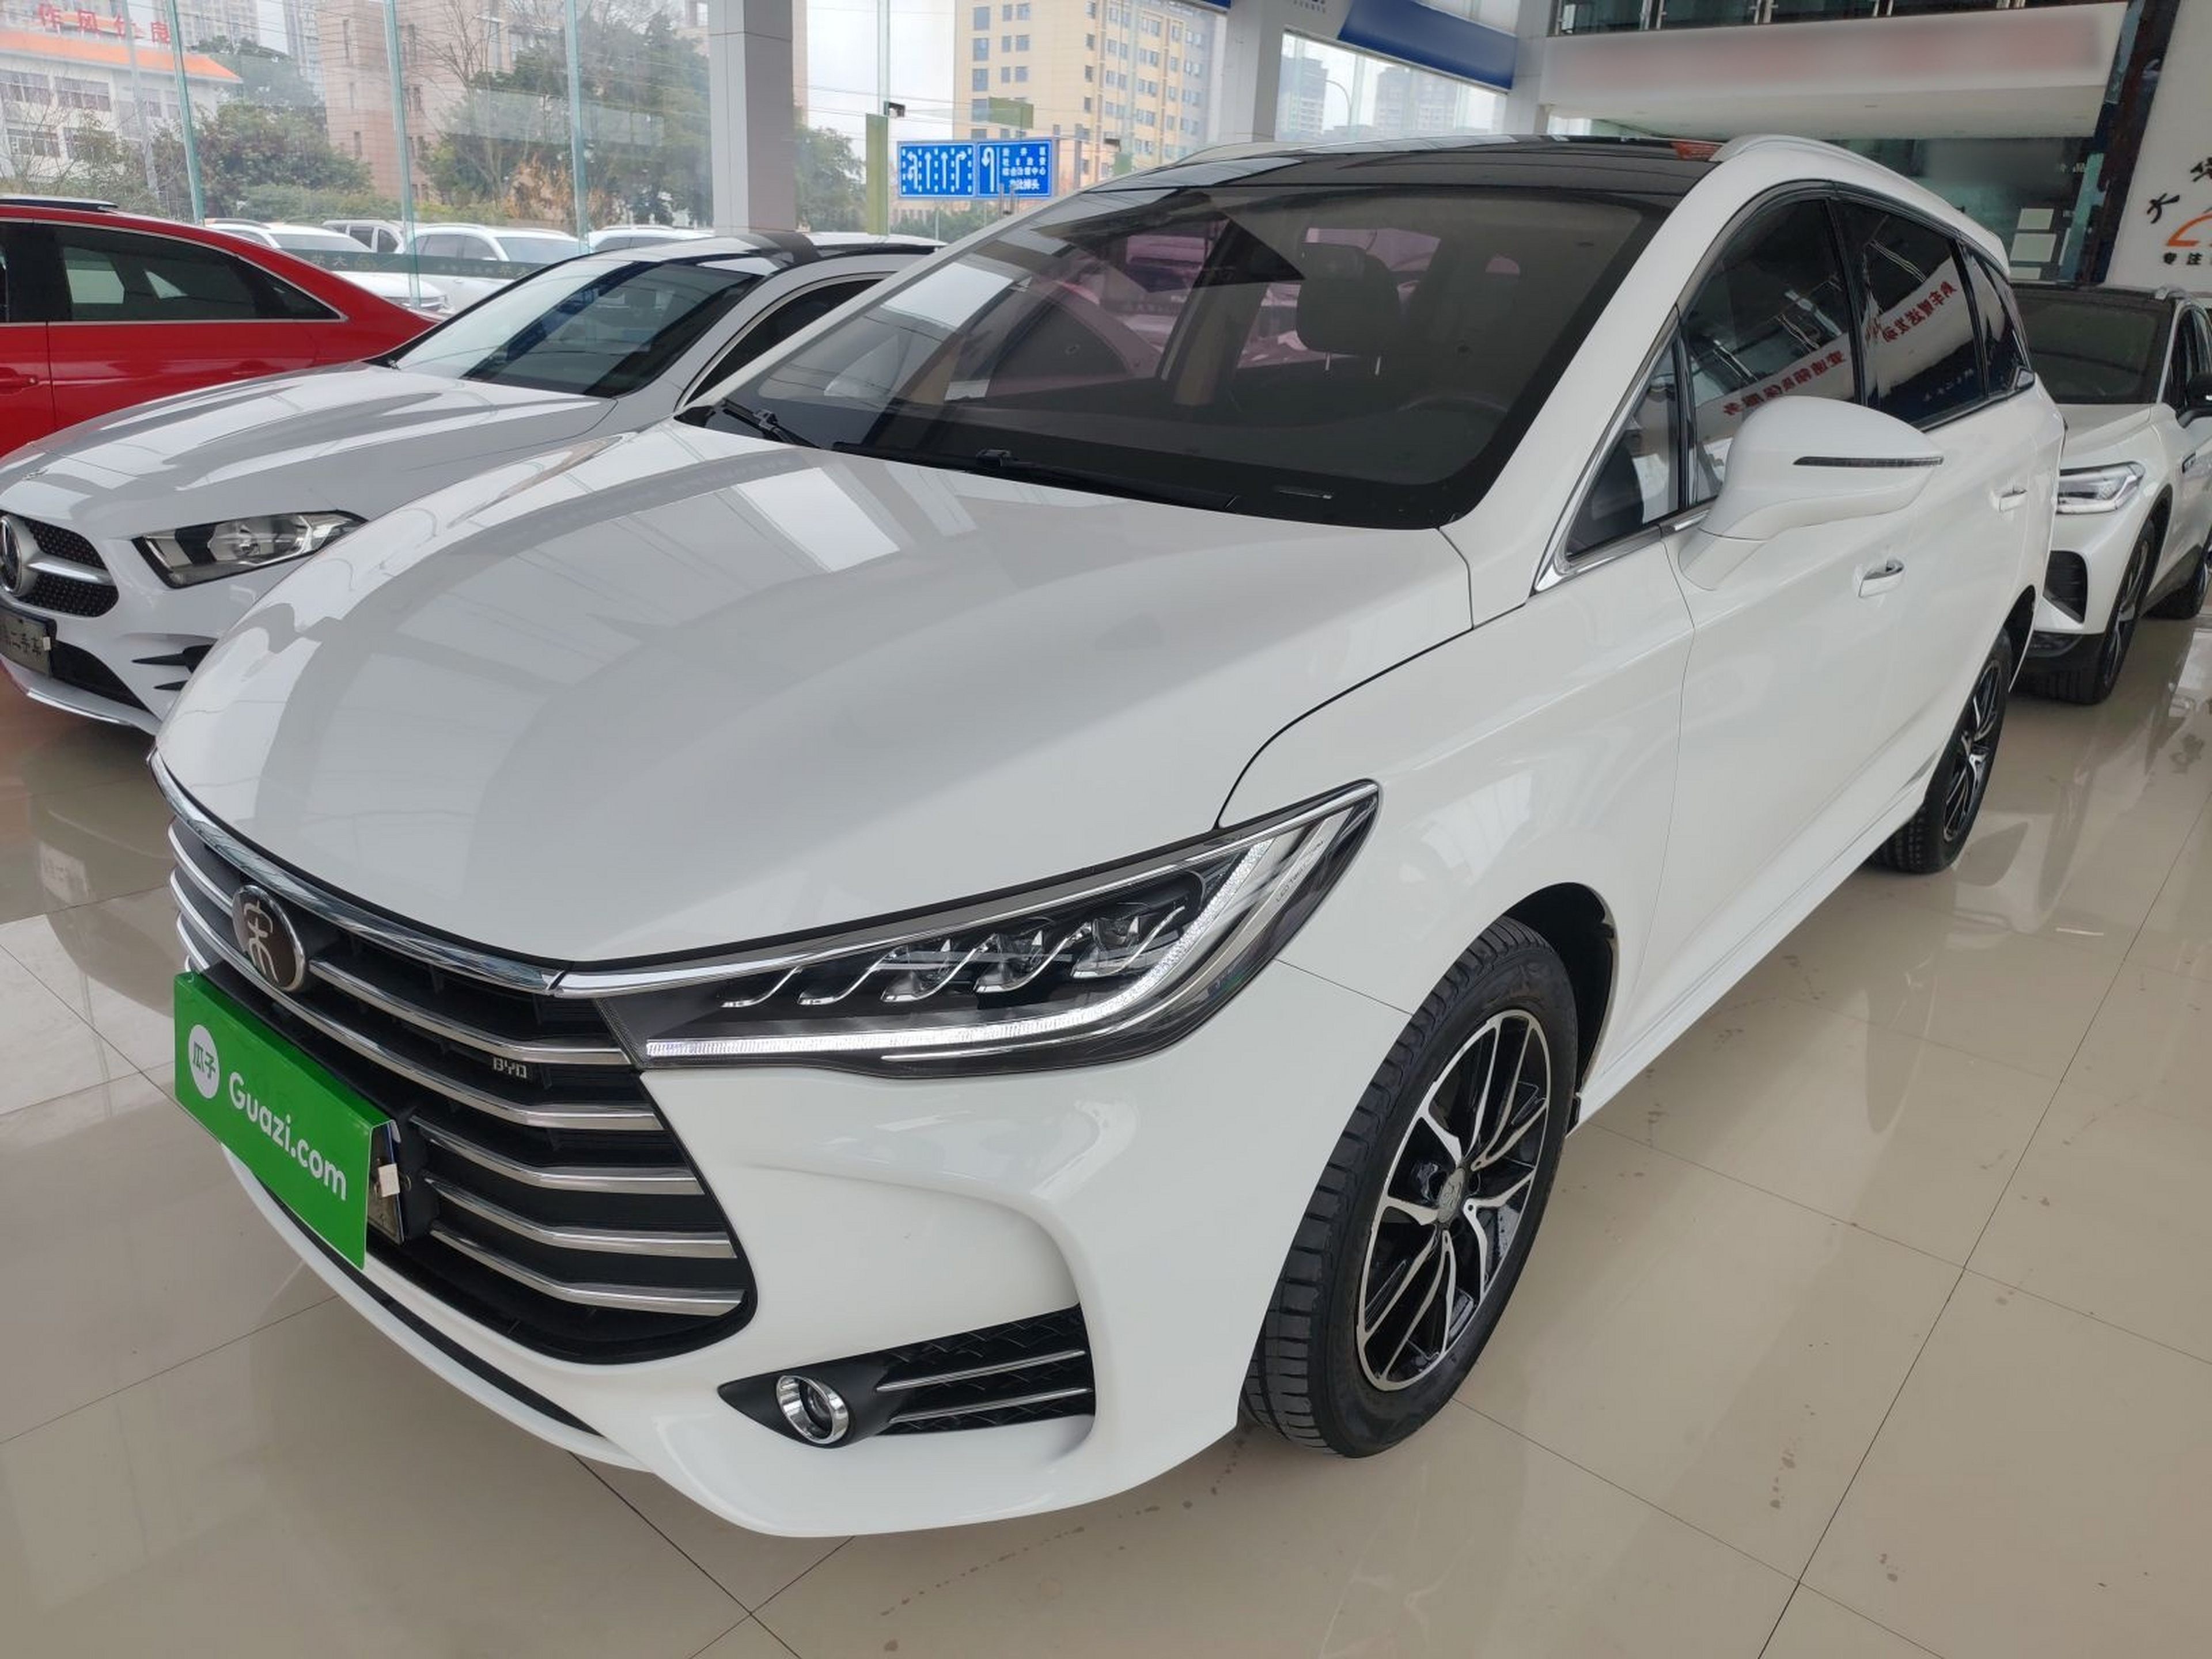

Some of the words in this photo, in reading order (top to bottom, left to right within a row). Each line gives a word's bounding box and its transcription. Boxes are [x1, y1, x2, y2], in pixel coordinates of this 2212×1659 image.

[193, 1041, 216, 1080] 瓜子
[494, 1058, 527, 1078] BYD
[229, 1071, 346, 1202] Guazi.com
